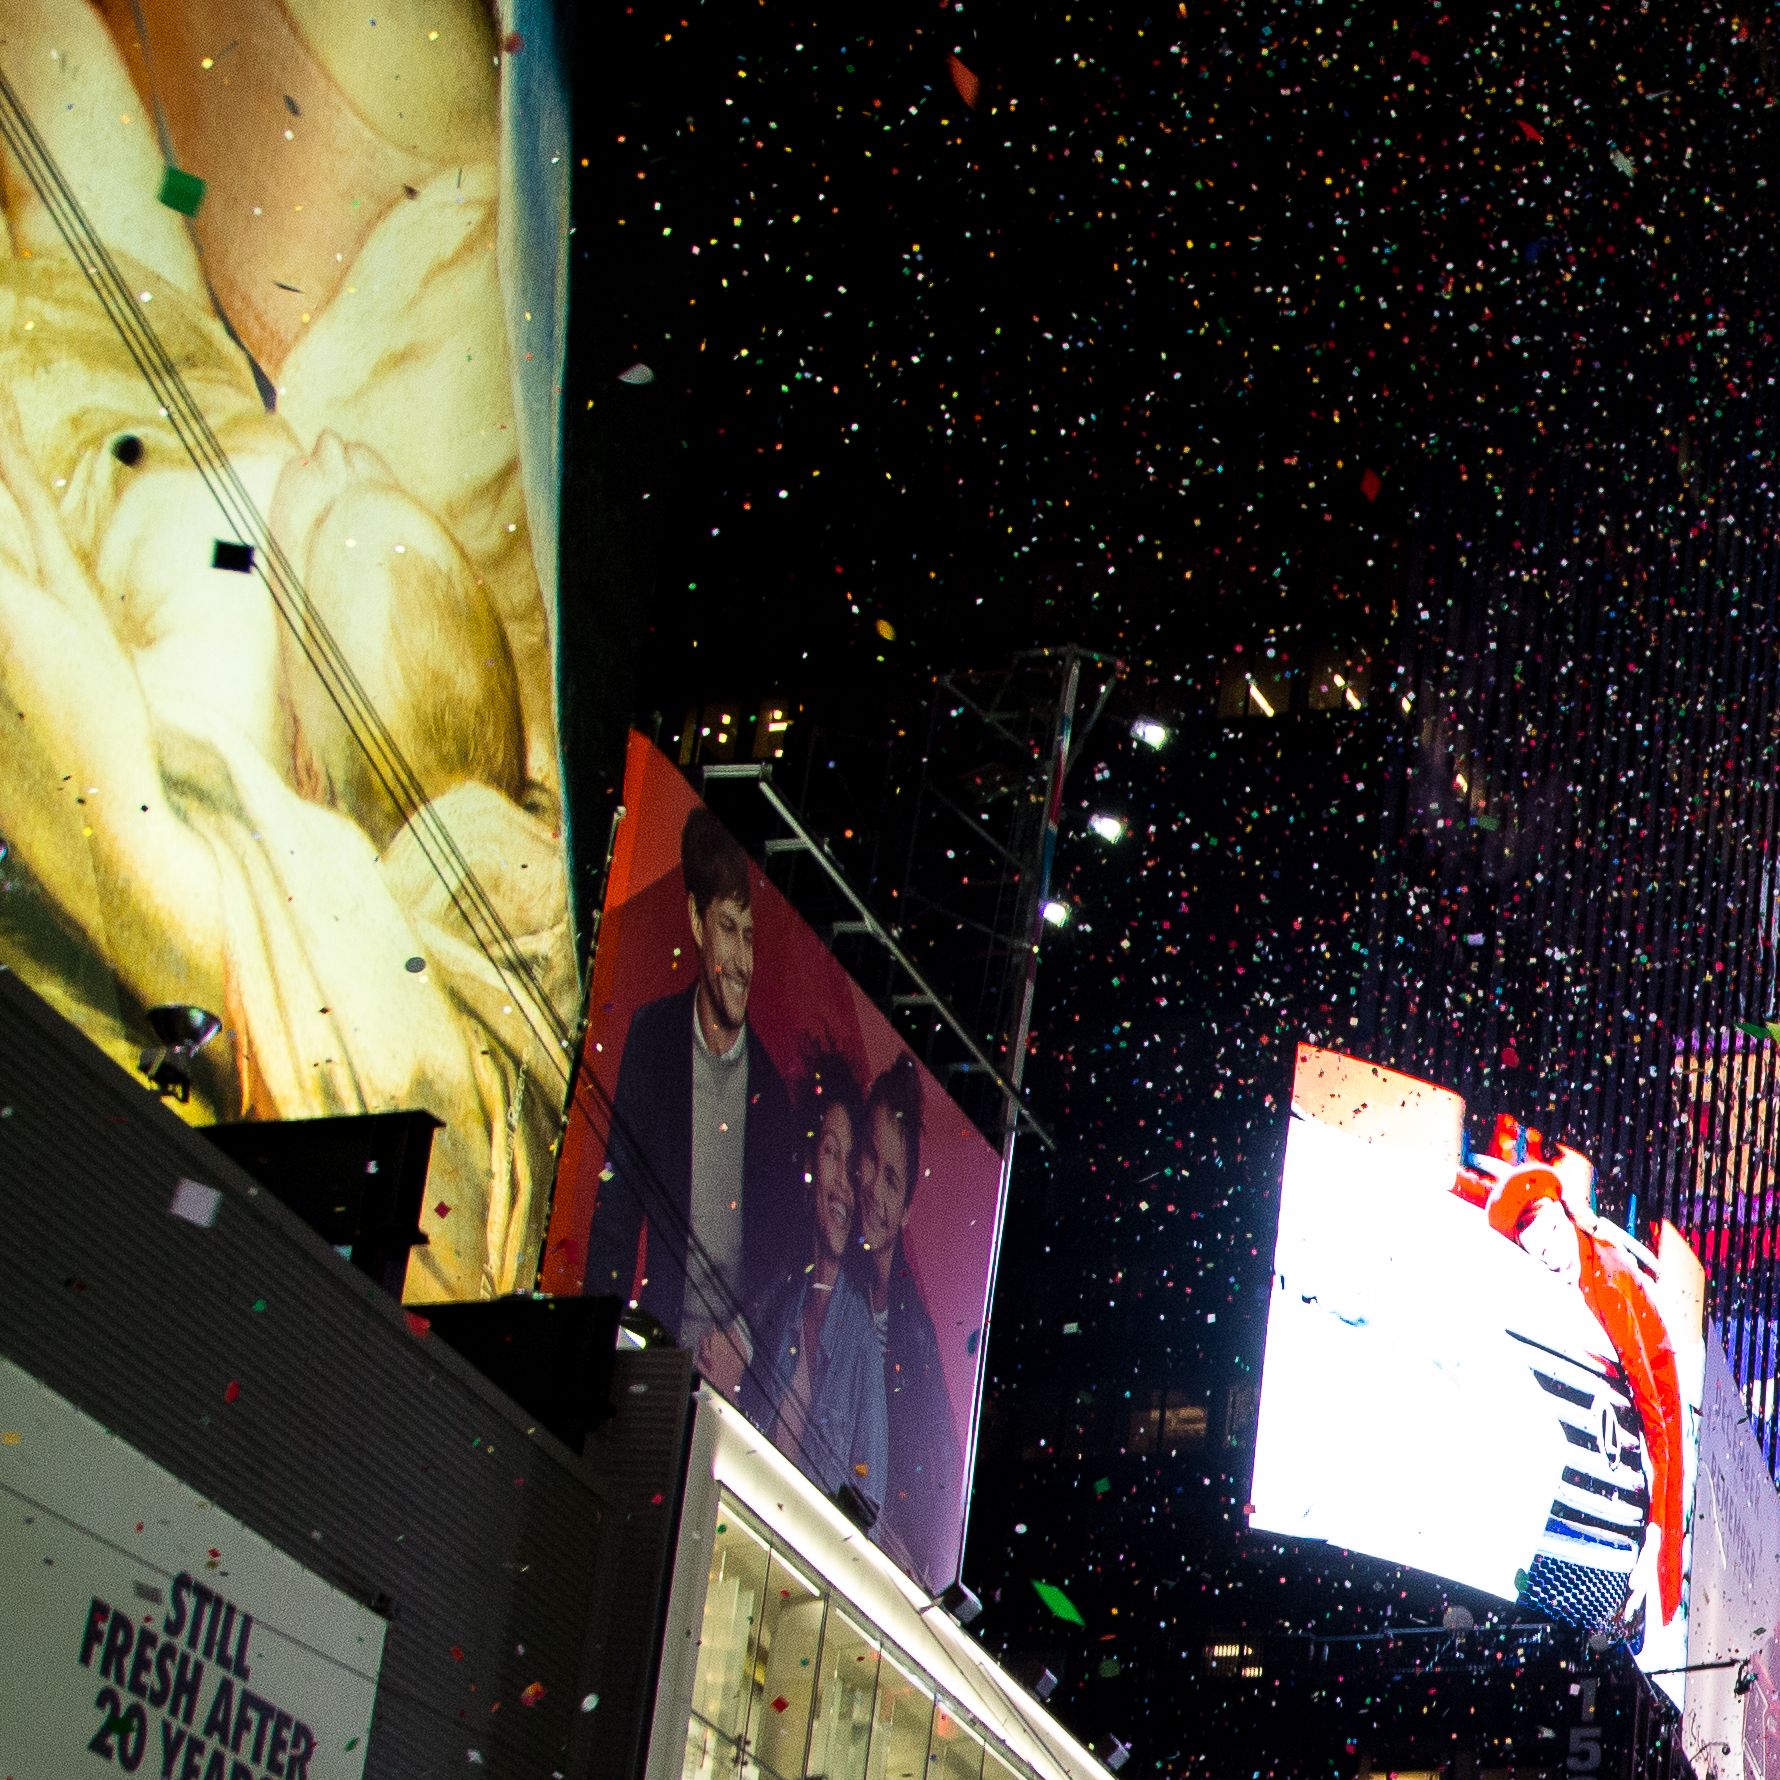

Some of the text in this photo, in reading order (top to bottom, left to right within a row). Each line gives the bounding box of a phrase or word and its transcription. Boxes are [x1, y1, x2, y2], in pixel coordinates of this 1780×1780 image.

[79, 1596, 205, 1726] FRESH
[164, 1570, 255, 1681] STILL
[87, 1686, 148, 1772] 20
